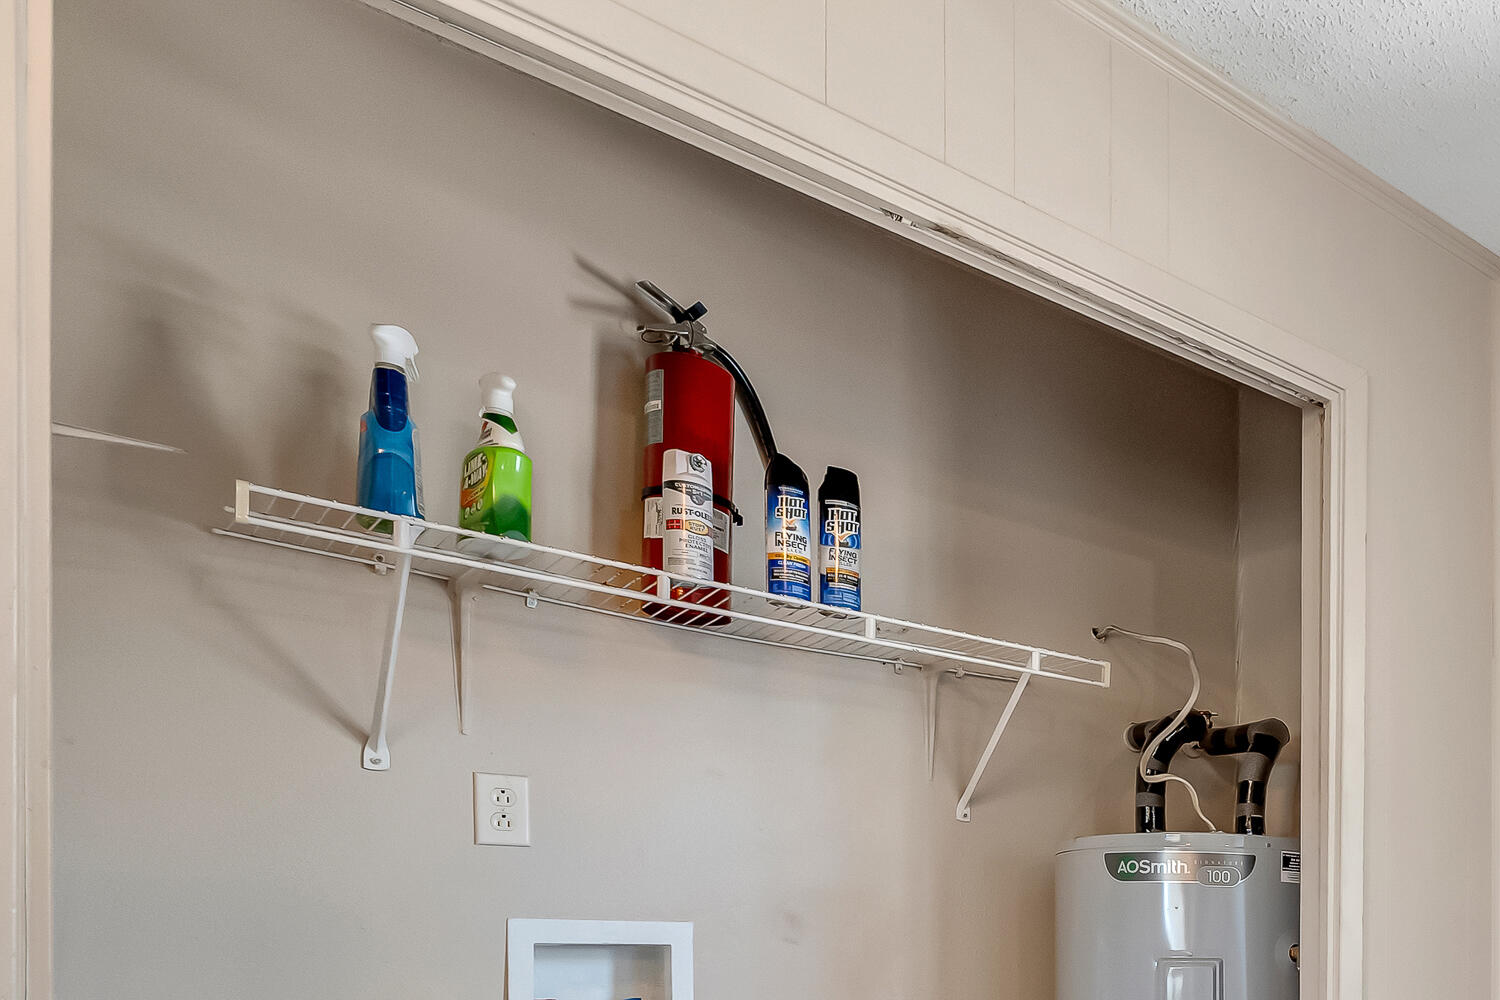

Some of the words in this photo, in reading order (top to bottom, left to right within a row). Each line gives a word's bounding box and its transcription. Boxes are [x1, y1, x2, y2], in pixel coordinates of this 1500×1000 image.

[778, 495, 805, 508] HOT
[775, 507, 808, 520] SHOT
[828, 508, 858, 521] HOT
[825, 520, 860, 534] SHOT
[829, 547, 858, 559] FYING
[1206, 869, 1231, 883] 100
